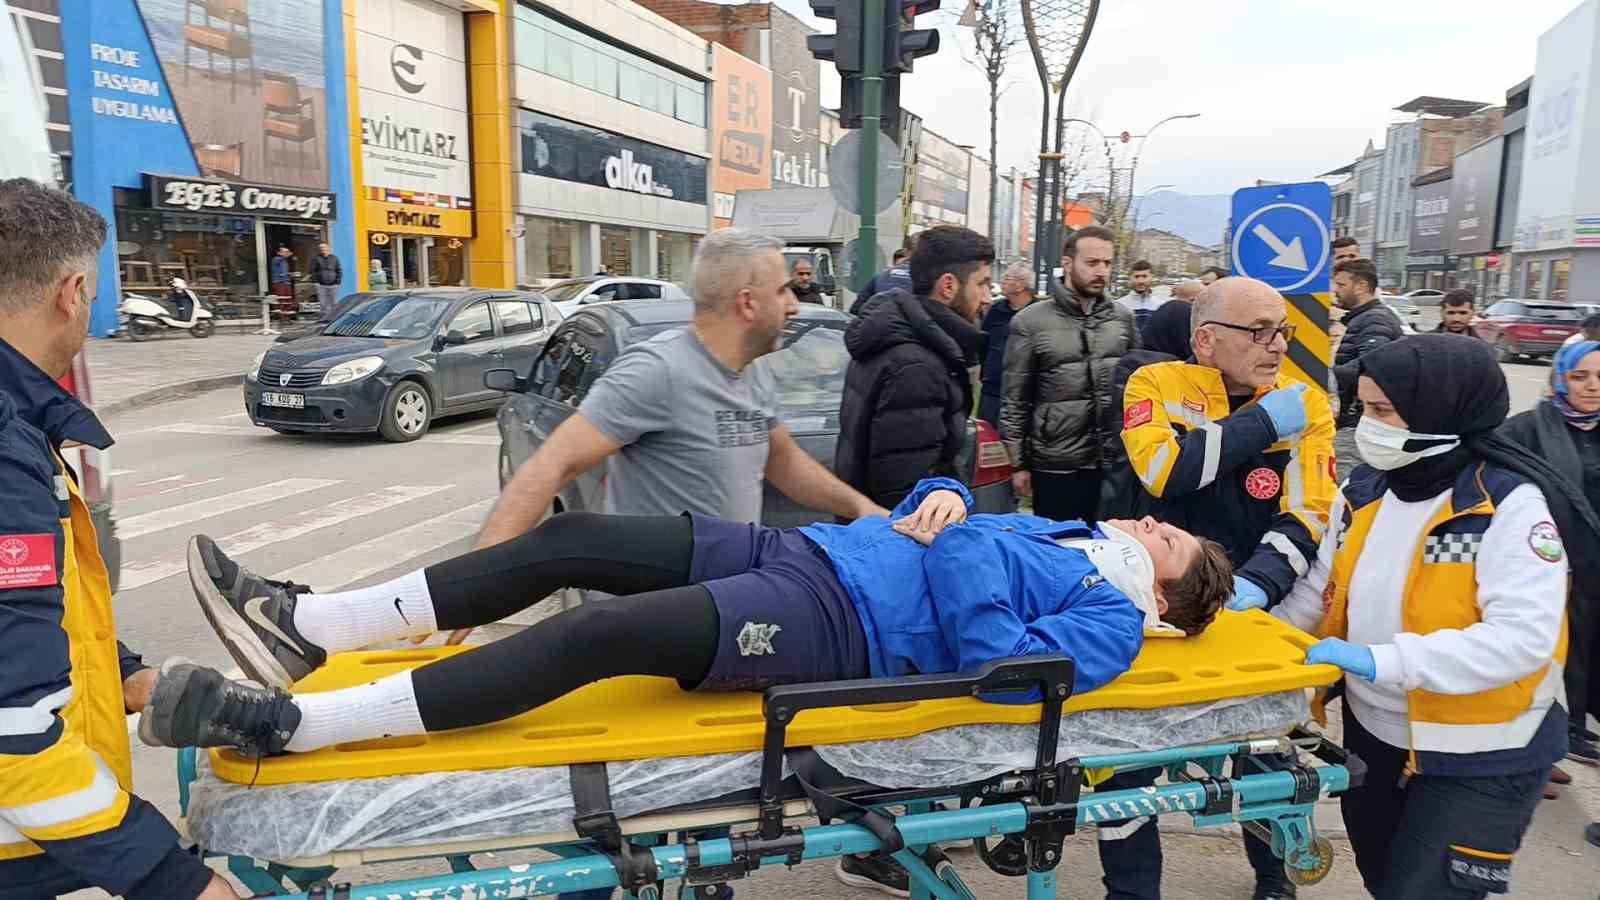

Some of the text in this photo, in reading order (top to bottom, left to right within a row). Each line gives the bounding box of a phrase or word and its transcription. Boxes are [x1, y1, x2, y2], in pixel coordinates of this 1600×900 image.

[91, 70, 160, 97] TASARIM
[605, 148, 652, 193] alka
[241, 187, 332, 219] Concept
